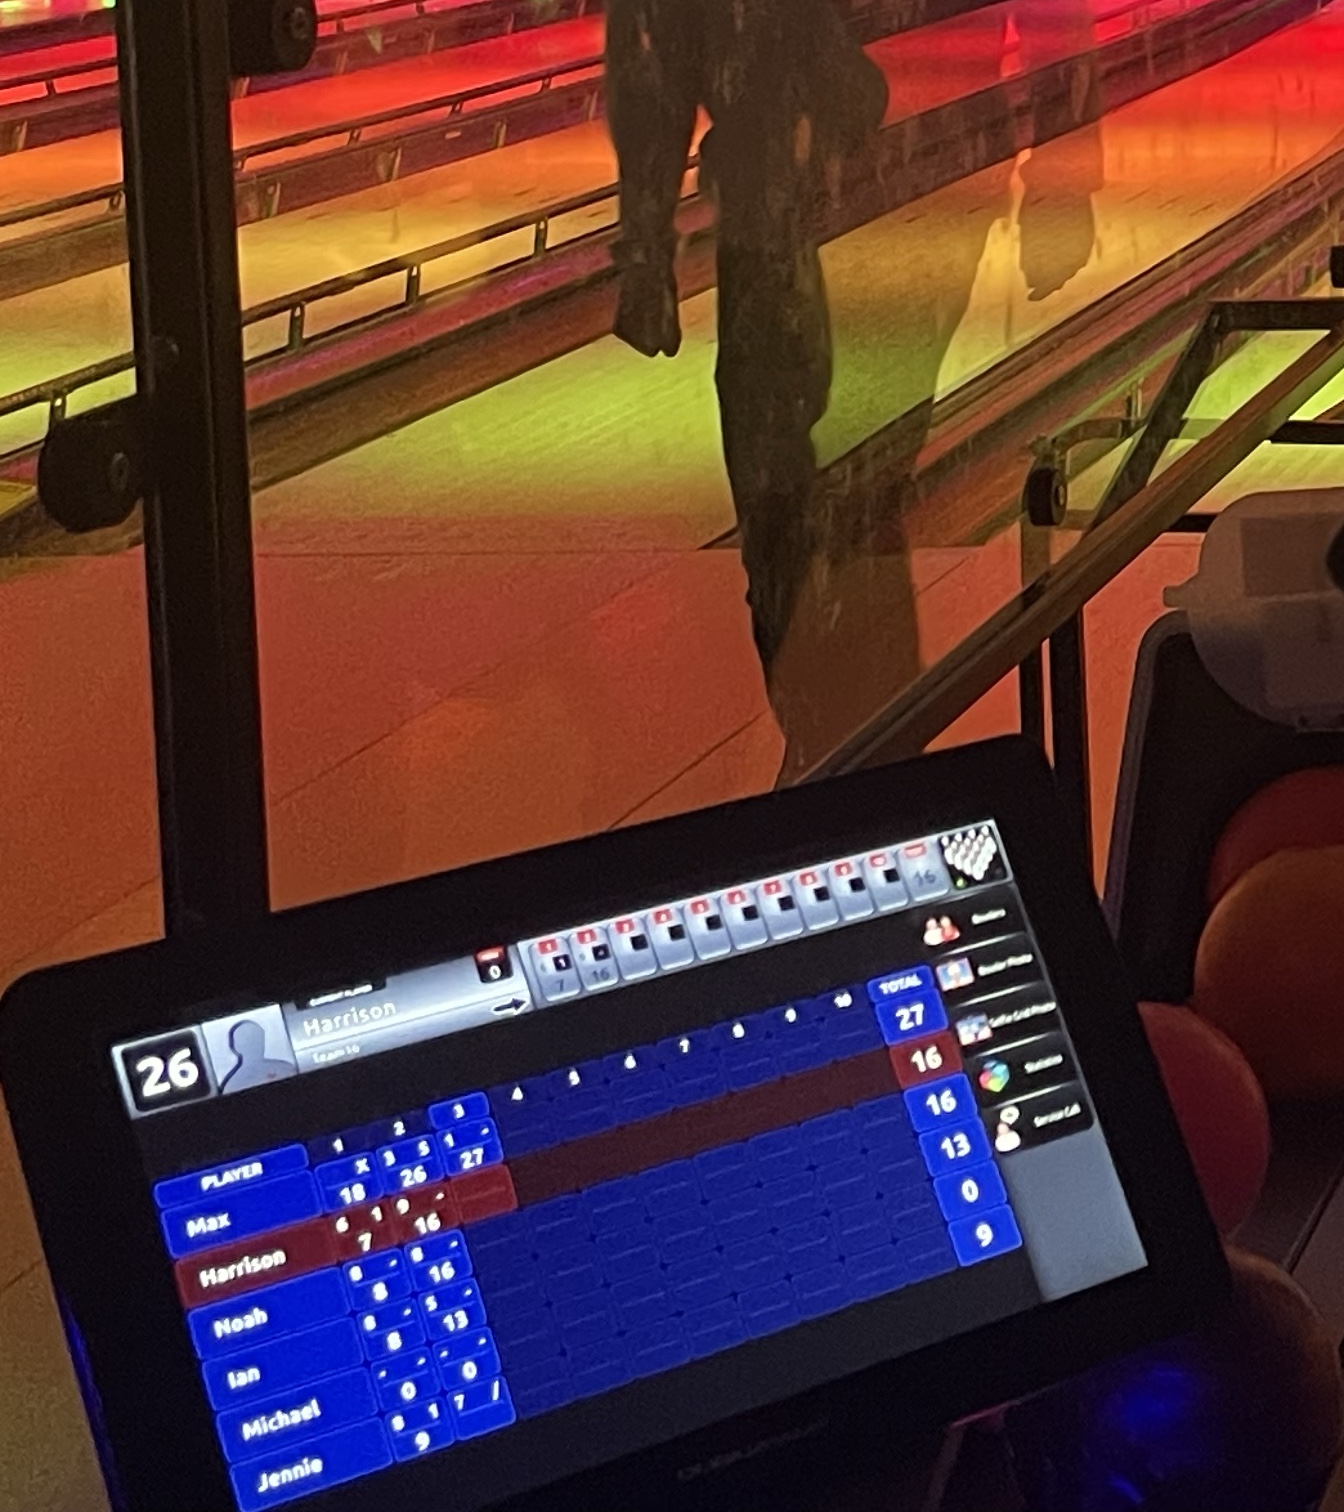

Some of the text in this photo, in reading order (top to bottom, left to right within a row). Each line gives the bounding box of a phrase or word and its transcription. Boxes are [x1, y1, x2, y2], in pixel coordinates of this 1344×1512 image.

[136, 1002, 396, 1097] 26 Harrison
[186, 1003, 925, 1238] Max 18 26 27 27
[199, 1045, 943, 1288] Harrison 16 16
[201, 972, 922, 1191] PLAYER TOTAL
[213, 1090, 957, 1339] Noah 16 16
[227, 1132, 971, 1389] Ian 13 13
[242, 1178, 979, 1441] Michael 0
[257, 1222, 993, 1493] Jennie 9
